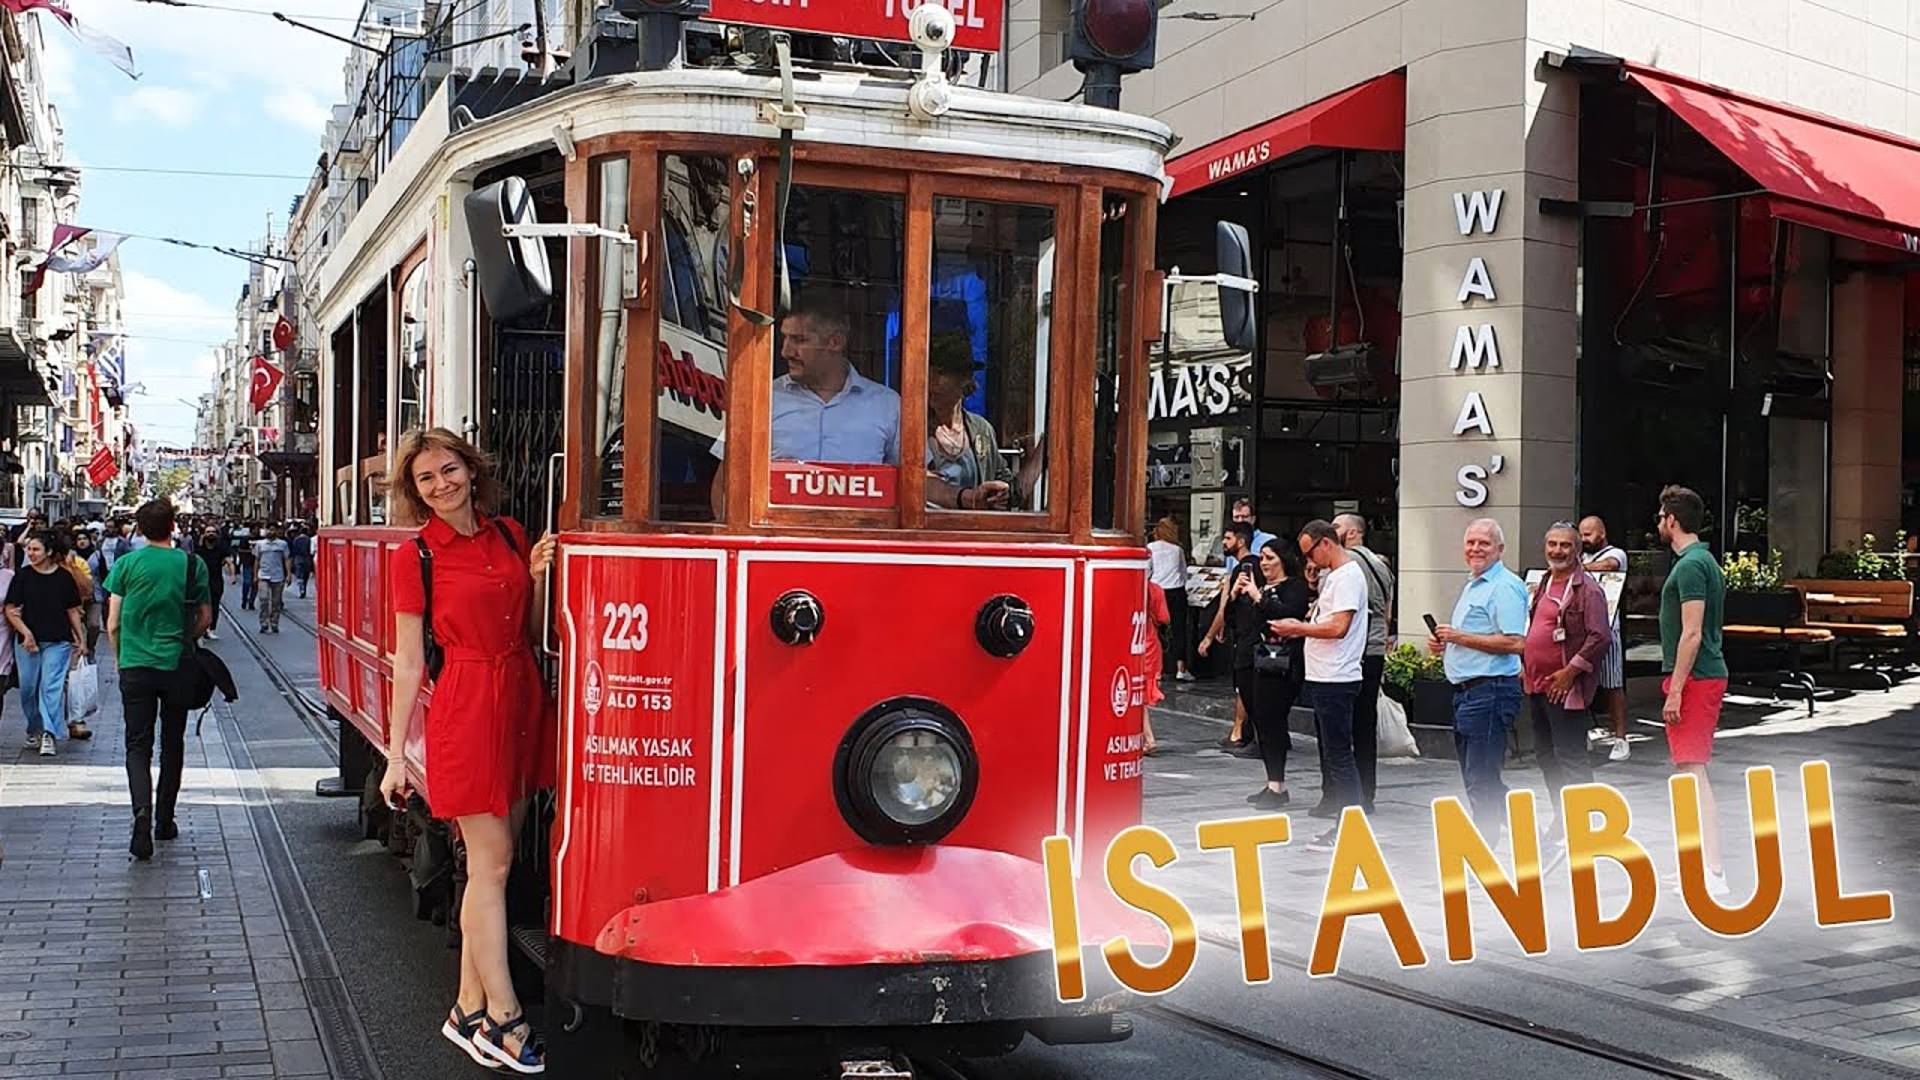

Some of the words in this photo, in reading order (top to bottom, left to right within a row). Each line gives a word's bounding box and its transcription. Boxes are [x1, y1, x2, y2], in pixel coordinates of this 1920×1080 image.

[1208, 140, 1270, 180] WAMA'S
[784, 470, 884, 498] TÜNEL
[602, 602, 649, 651] 223
[607, 692, 637, 709] ALO
[641, 694, 673, 711] 153
[584, 734, 639, 756] ASILMAK
[642, 738, 693, 757] YASAK
[582, 762, 595, 782] VE
[597, 762, 697, 787] TEHLİKELİDİR
[1103, 762, 1117, 781] VE
